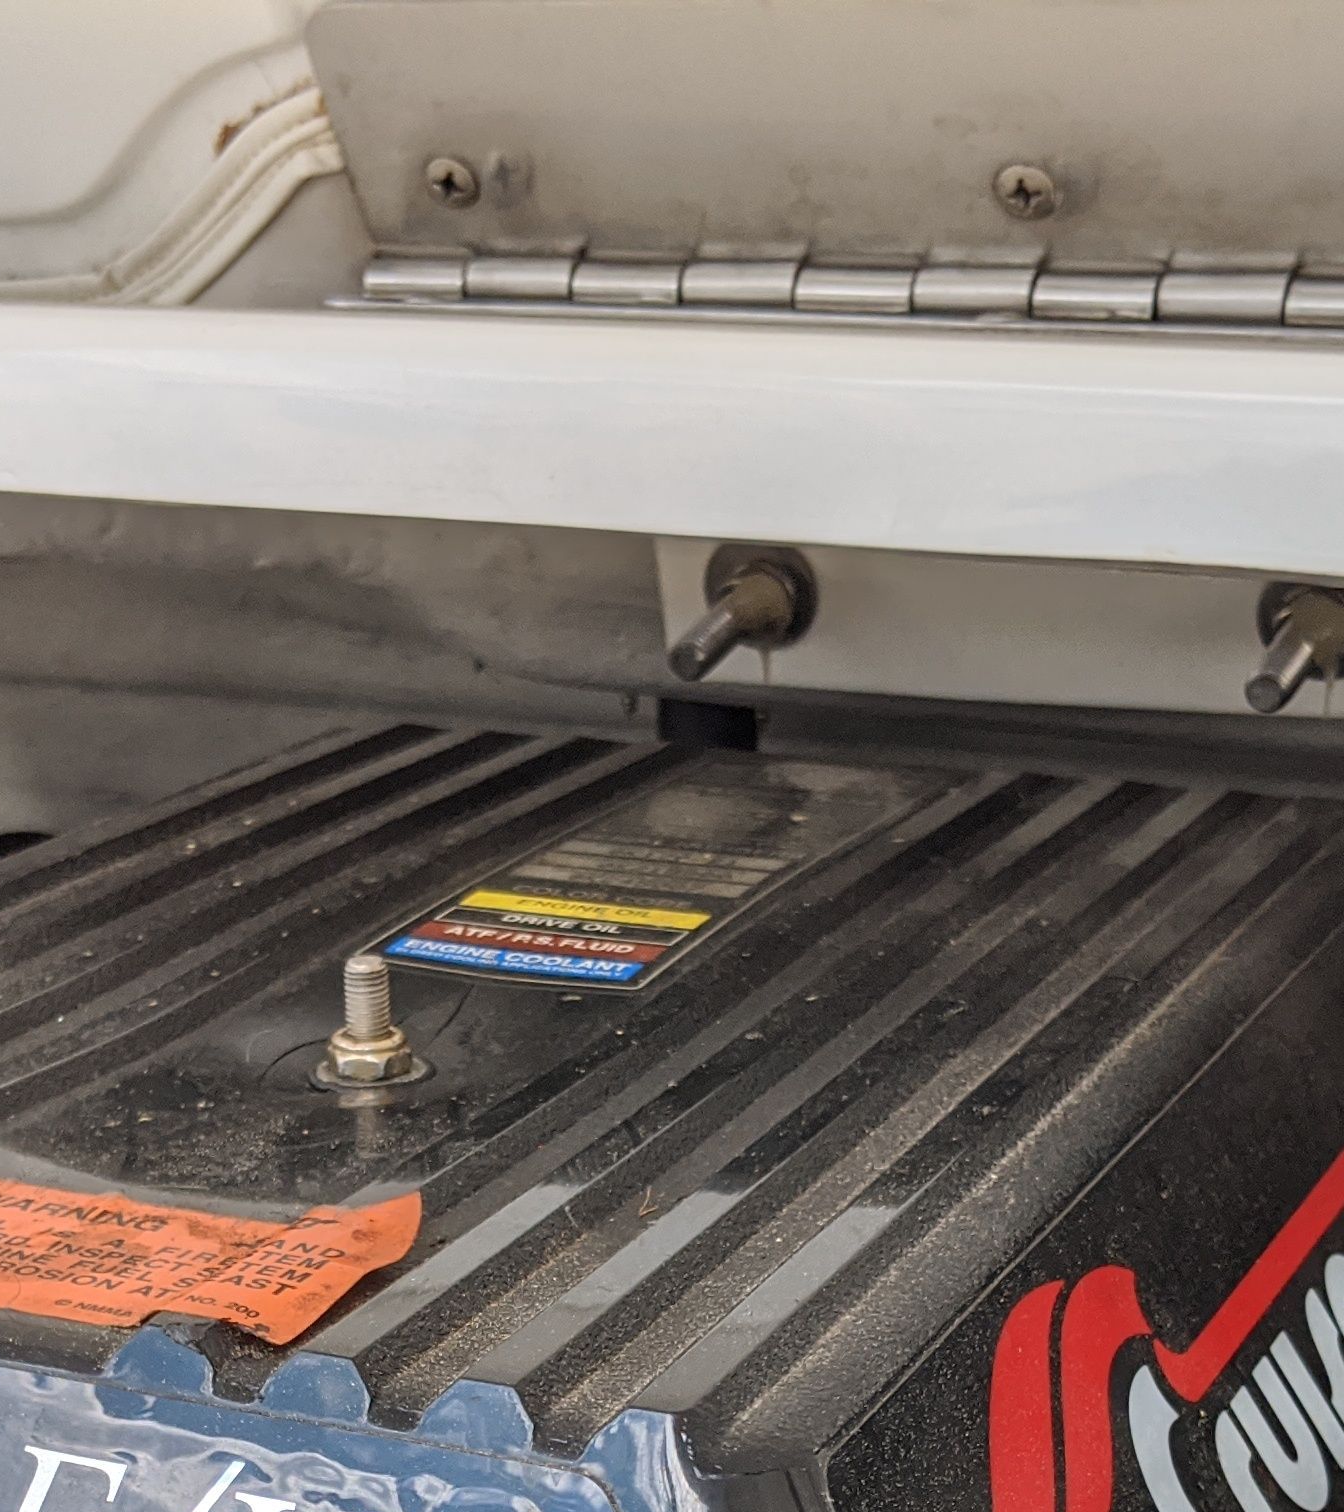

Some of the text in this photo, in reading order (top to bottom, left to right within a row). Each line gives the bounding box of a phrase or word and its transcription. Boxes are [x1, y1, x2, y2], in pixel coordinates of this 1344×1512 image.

[516, 899, 652, 919] ENGINE OIL
[501, 914, 623, 935] DRIVE OIL
[443, 925, 498, 938] ATF
[559, 939, 636, 954] FLUID
[403, 939, 502, 959] ENGINE
[503, 951, 632, 972] COOLANT
[37, 1228, 80, 1239] IS
[100, 1239, 125, 1249] A
[261, 1239, 346, 1260] AND
[45, 1240, 193, 1272] INSPECT
[66, 1259, 153, 1283] FUEL
[125, 1285, 179, 1299] AT
[184, 1294, 218, 1307] NO.
